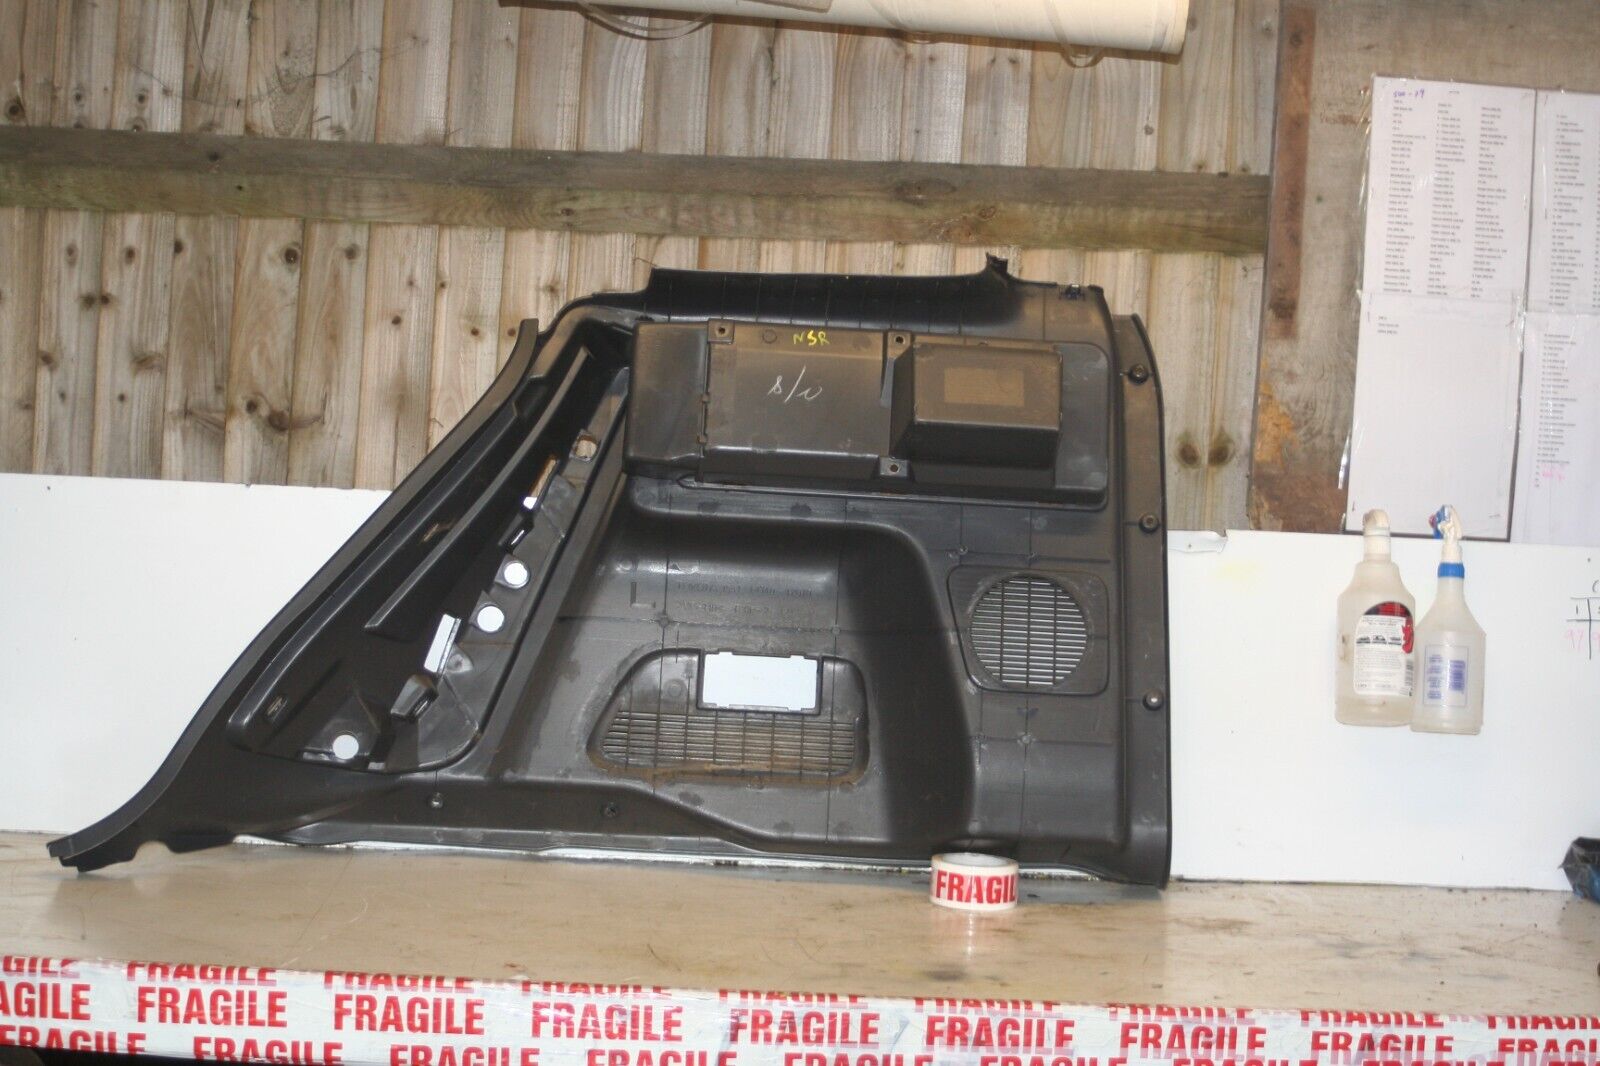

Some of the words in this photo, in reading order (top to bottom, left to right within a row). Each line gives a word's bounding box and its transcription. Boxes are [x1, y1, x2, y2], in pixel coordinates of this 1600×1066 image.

[792, 329, 831, 347] NSR
[137, 986, 288, 1028] FRAGILE
[334, 993, 485, 1035] FRAGILE
[531, 1001, 683, 1042] FRAGILE
[729, 1008, 880, 1049] FRAGILE
[925, 1015, 1075, 1056] FRAGILE
[1120, 1022, 1267, 1062] FRAGILE
[1311, 1031, 1454, 1063] FRAGILE
